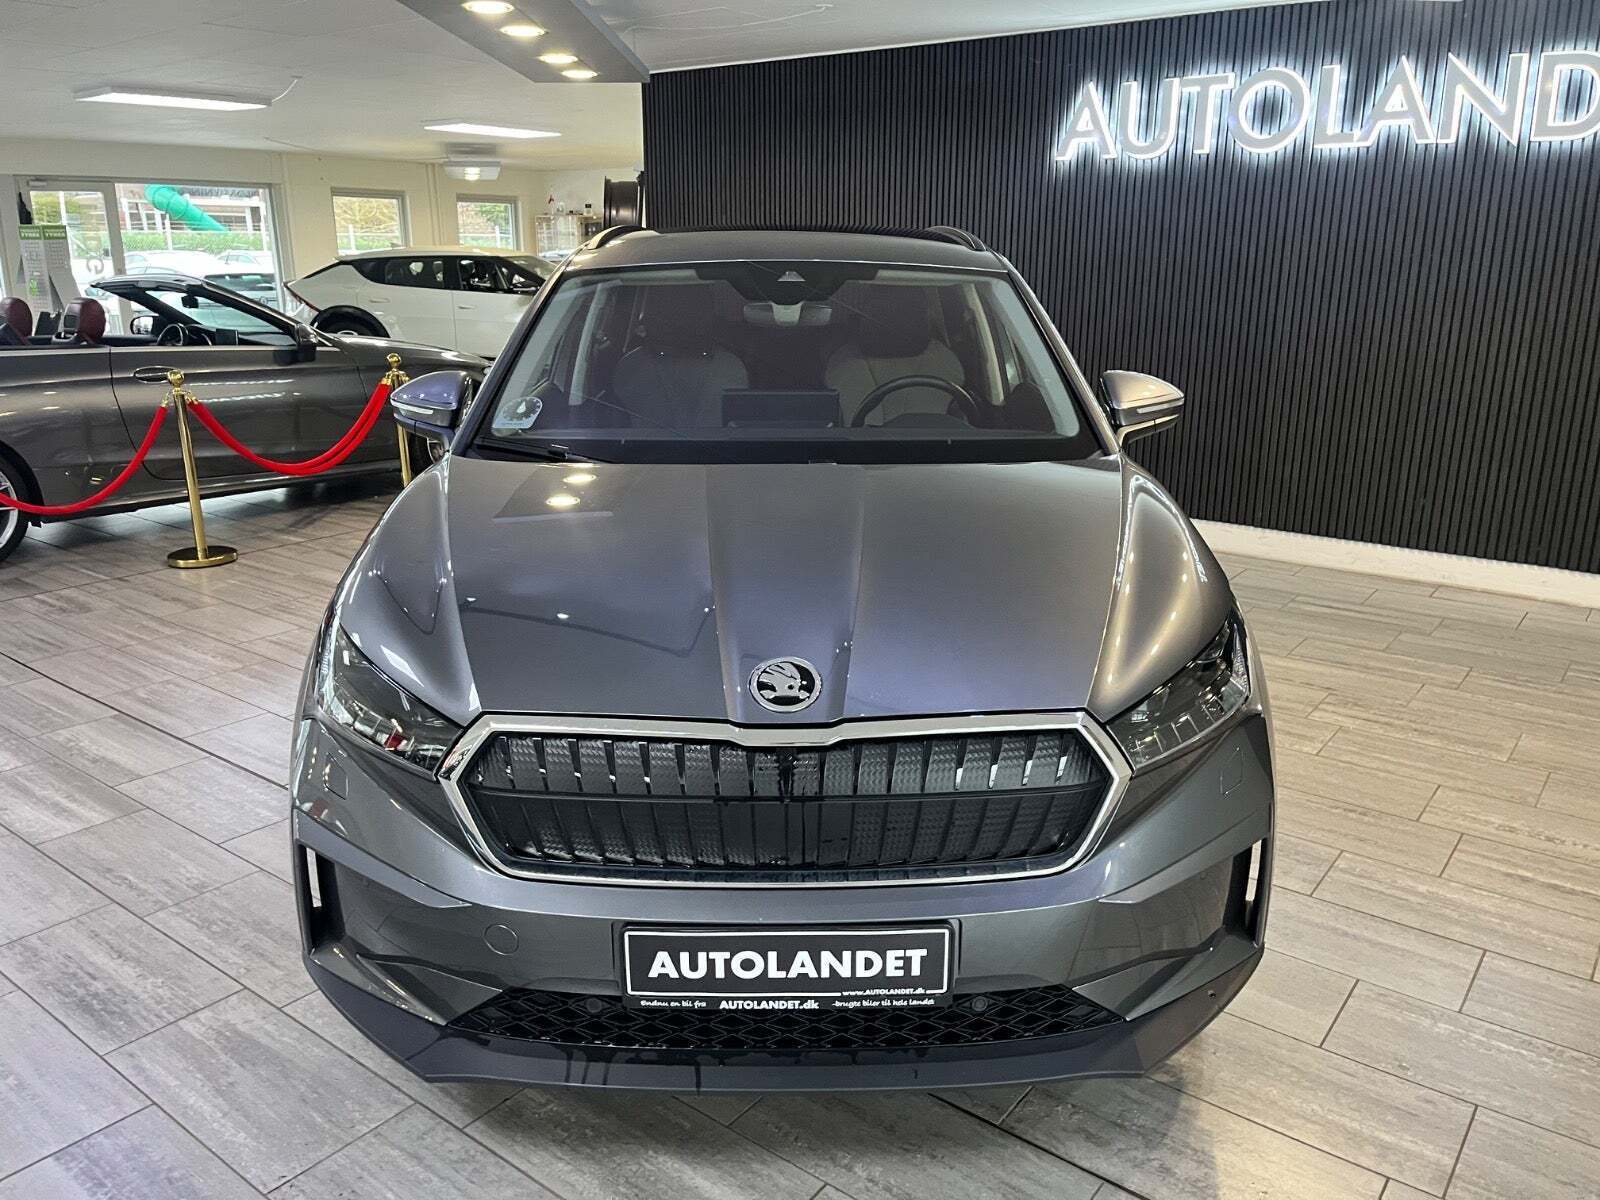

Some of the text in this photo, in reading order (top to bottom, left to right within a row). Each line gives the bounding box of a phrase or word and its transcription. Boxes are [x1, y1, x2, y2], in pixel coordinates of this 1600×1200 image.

[648, 949, 928, 979] AUTOLANDET
[842, 987, 925, 996] www.AUTOLANDET.dk
[720, 1000, 820, 1010] AUTOLANDET.dk
